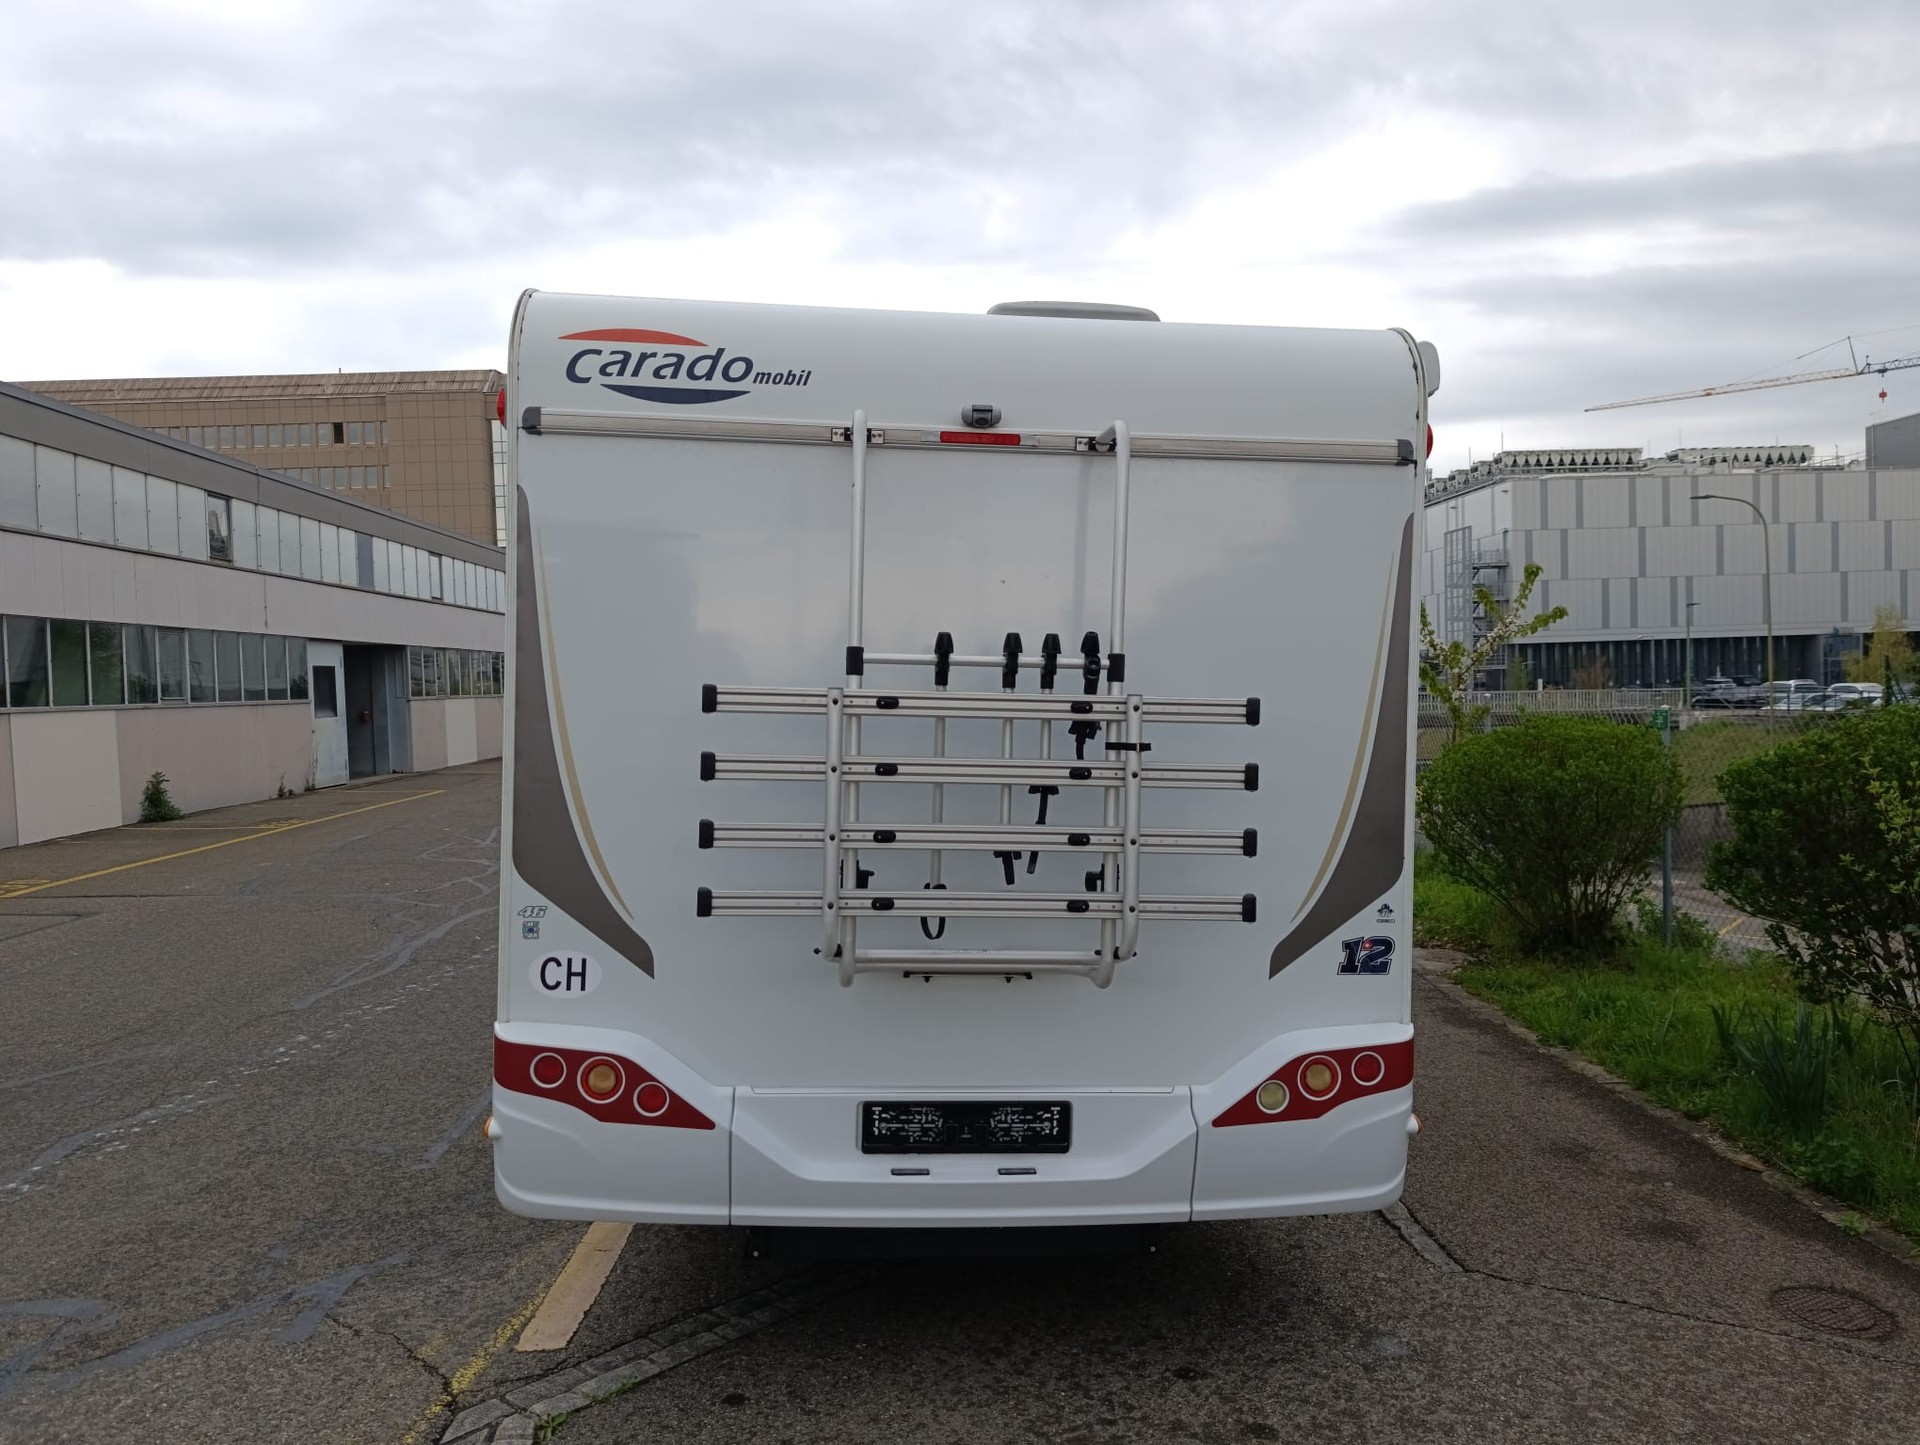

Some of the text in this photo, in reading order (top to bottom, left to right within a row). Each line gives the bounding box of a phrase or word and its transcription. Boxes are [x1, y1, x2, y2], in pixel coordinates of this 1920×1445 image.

[752, 370, 812, 387] mobil
[517, 905, 548, 919] 46
[1336, 935, 1396, 976] 12
[540, 956, 587, 992] CH
